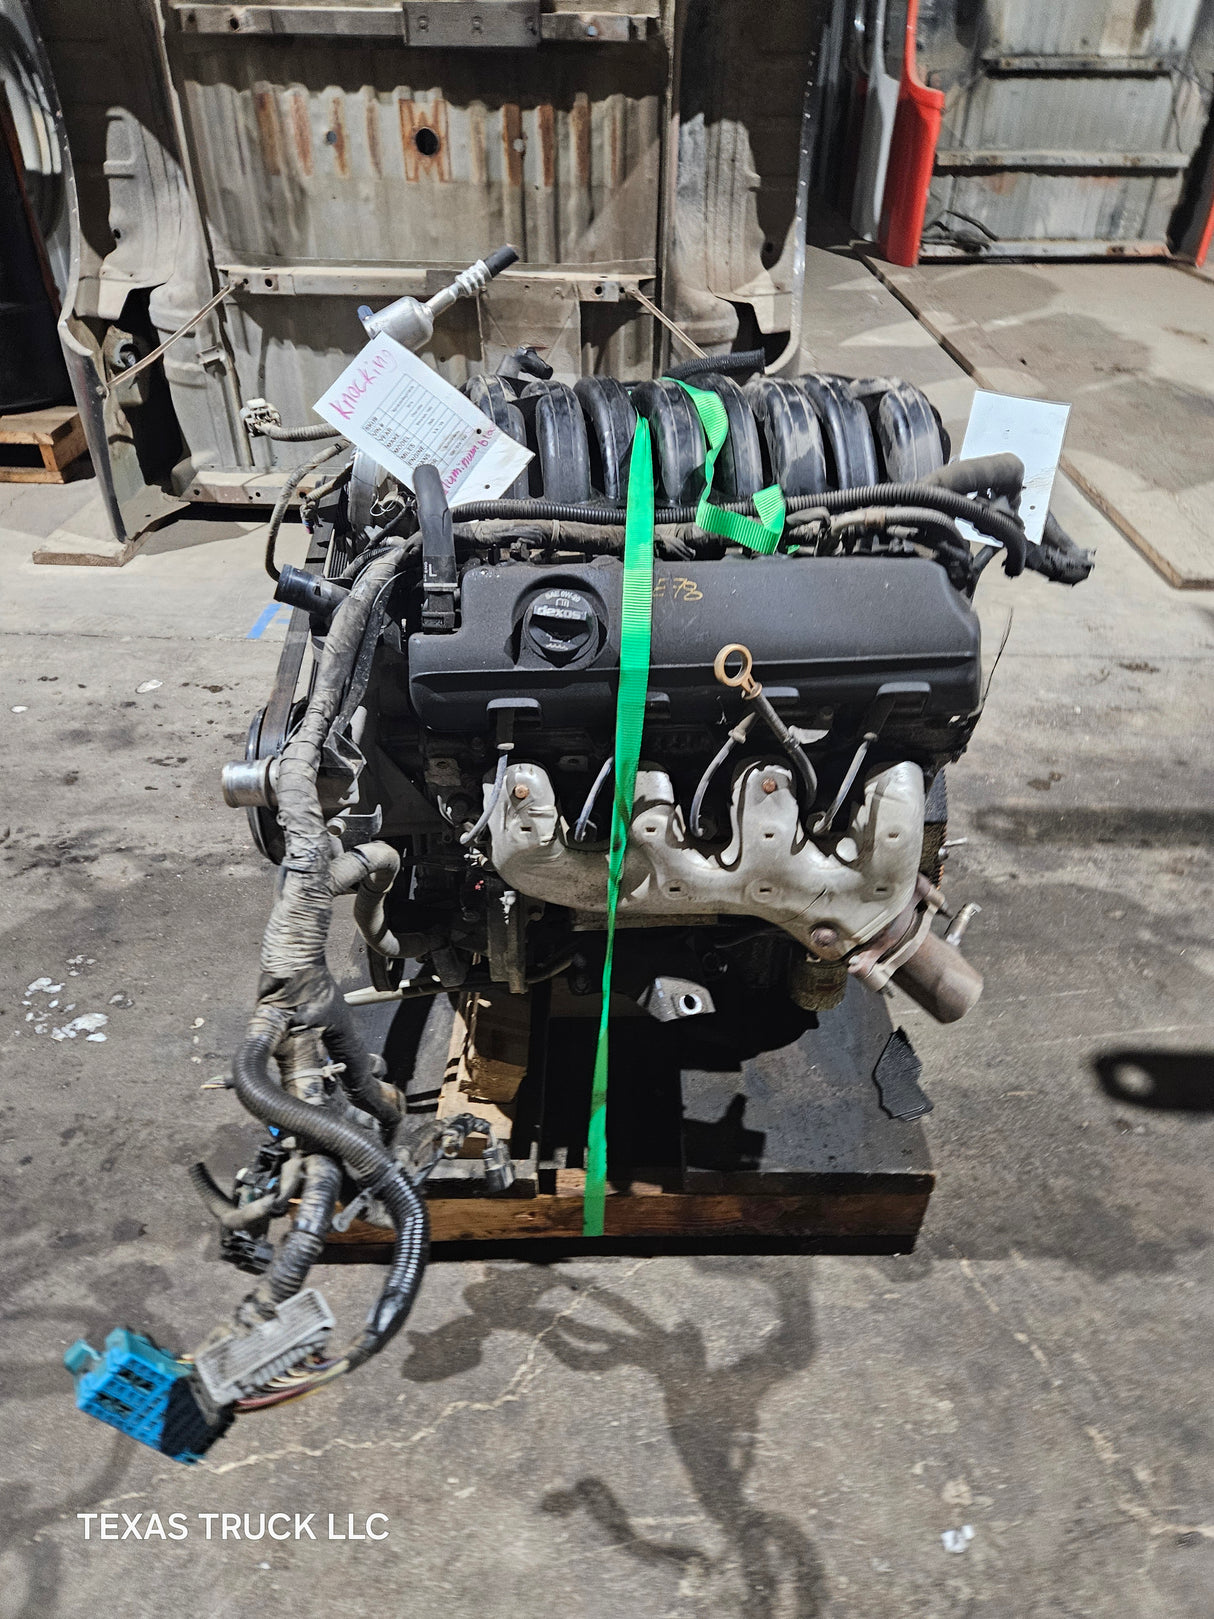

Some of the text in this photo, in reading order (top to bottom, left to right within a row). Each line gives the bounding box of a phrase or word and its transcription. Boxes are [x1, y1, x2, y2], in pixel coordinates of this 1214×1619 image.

[379, 427, 393, 441] YEAR
[386, 433, 400, 448] MAKE
[394, 436, 410, 453] MODEL
[401, 443, 416, 459] MILES
[408, 446, 425, 465] ENGINE
[441, 445, 479, 494] luminum
